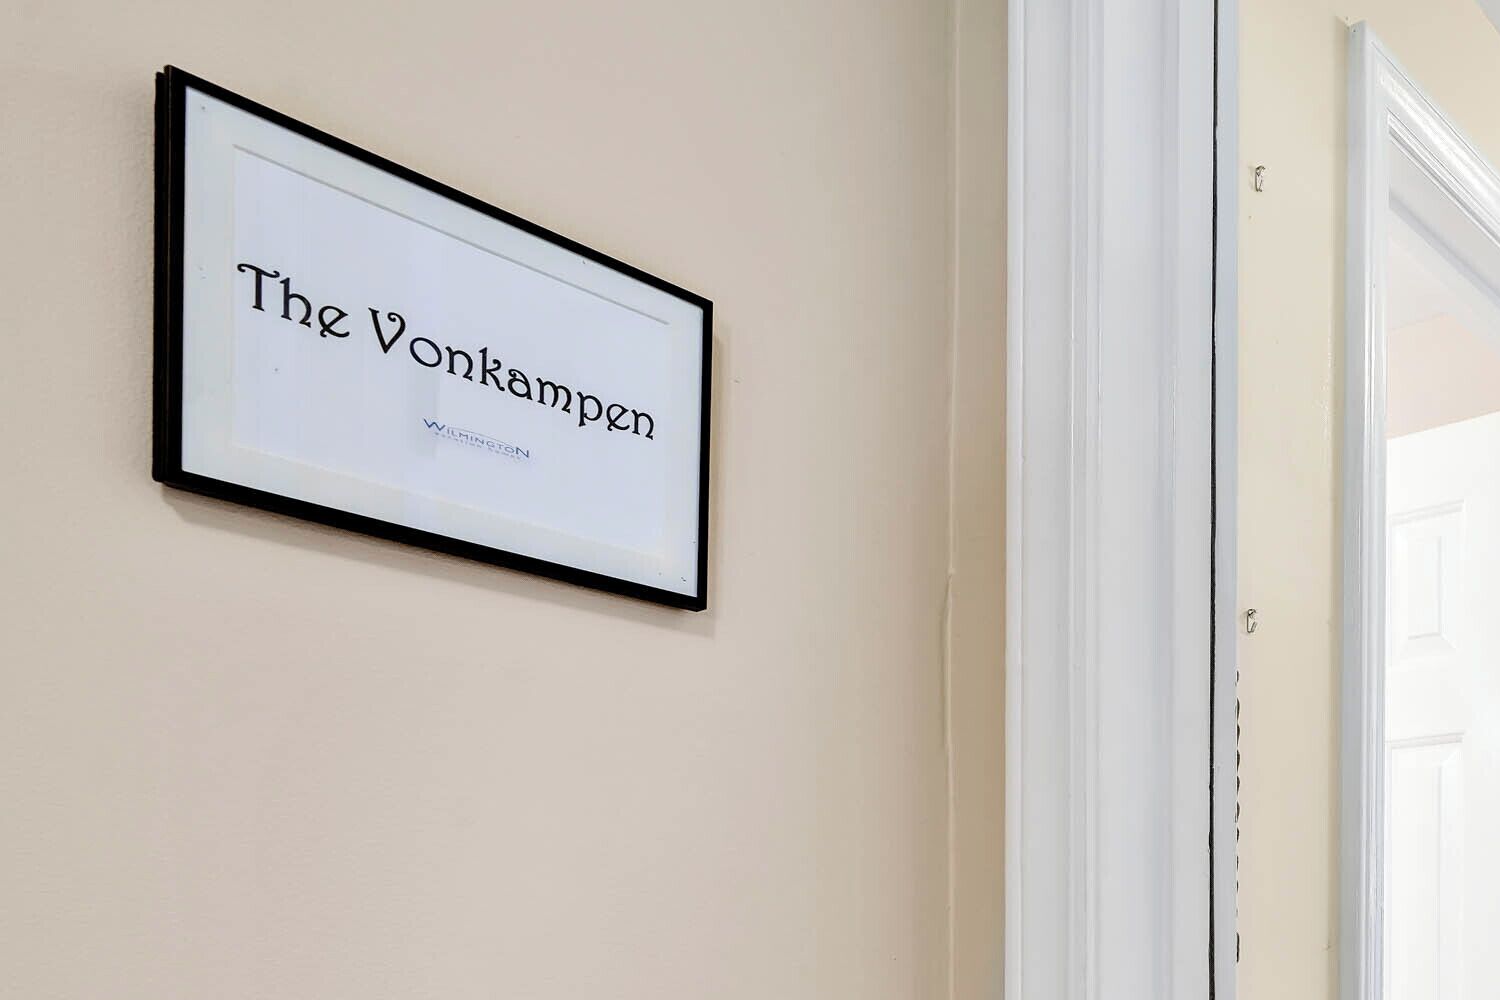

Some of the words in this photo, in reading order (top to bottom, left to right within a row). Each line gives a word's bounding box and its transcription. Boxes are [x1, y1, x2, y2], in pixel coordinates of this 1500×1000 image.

[236, 263, 350, 338] The
[367, 307, 654, 441] Vonkampen
[422, 417, 530, 458] WILMINGTON
